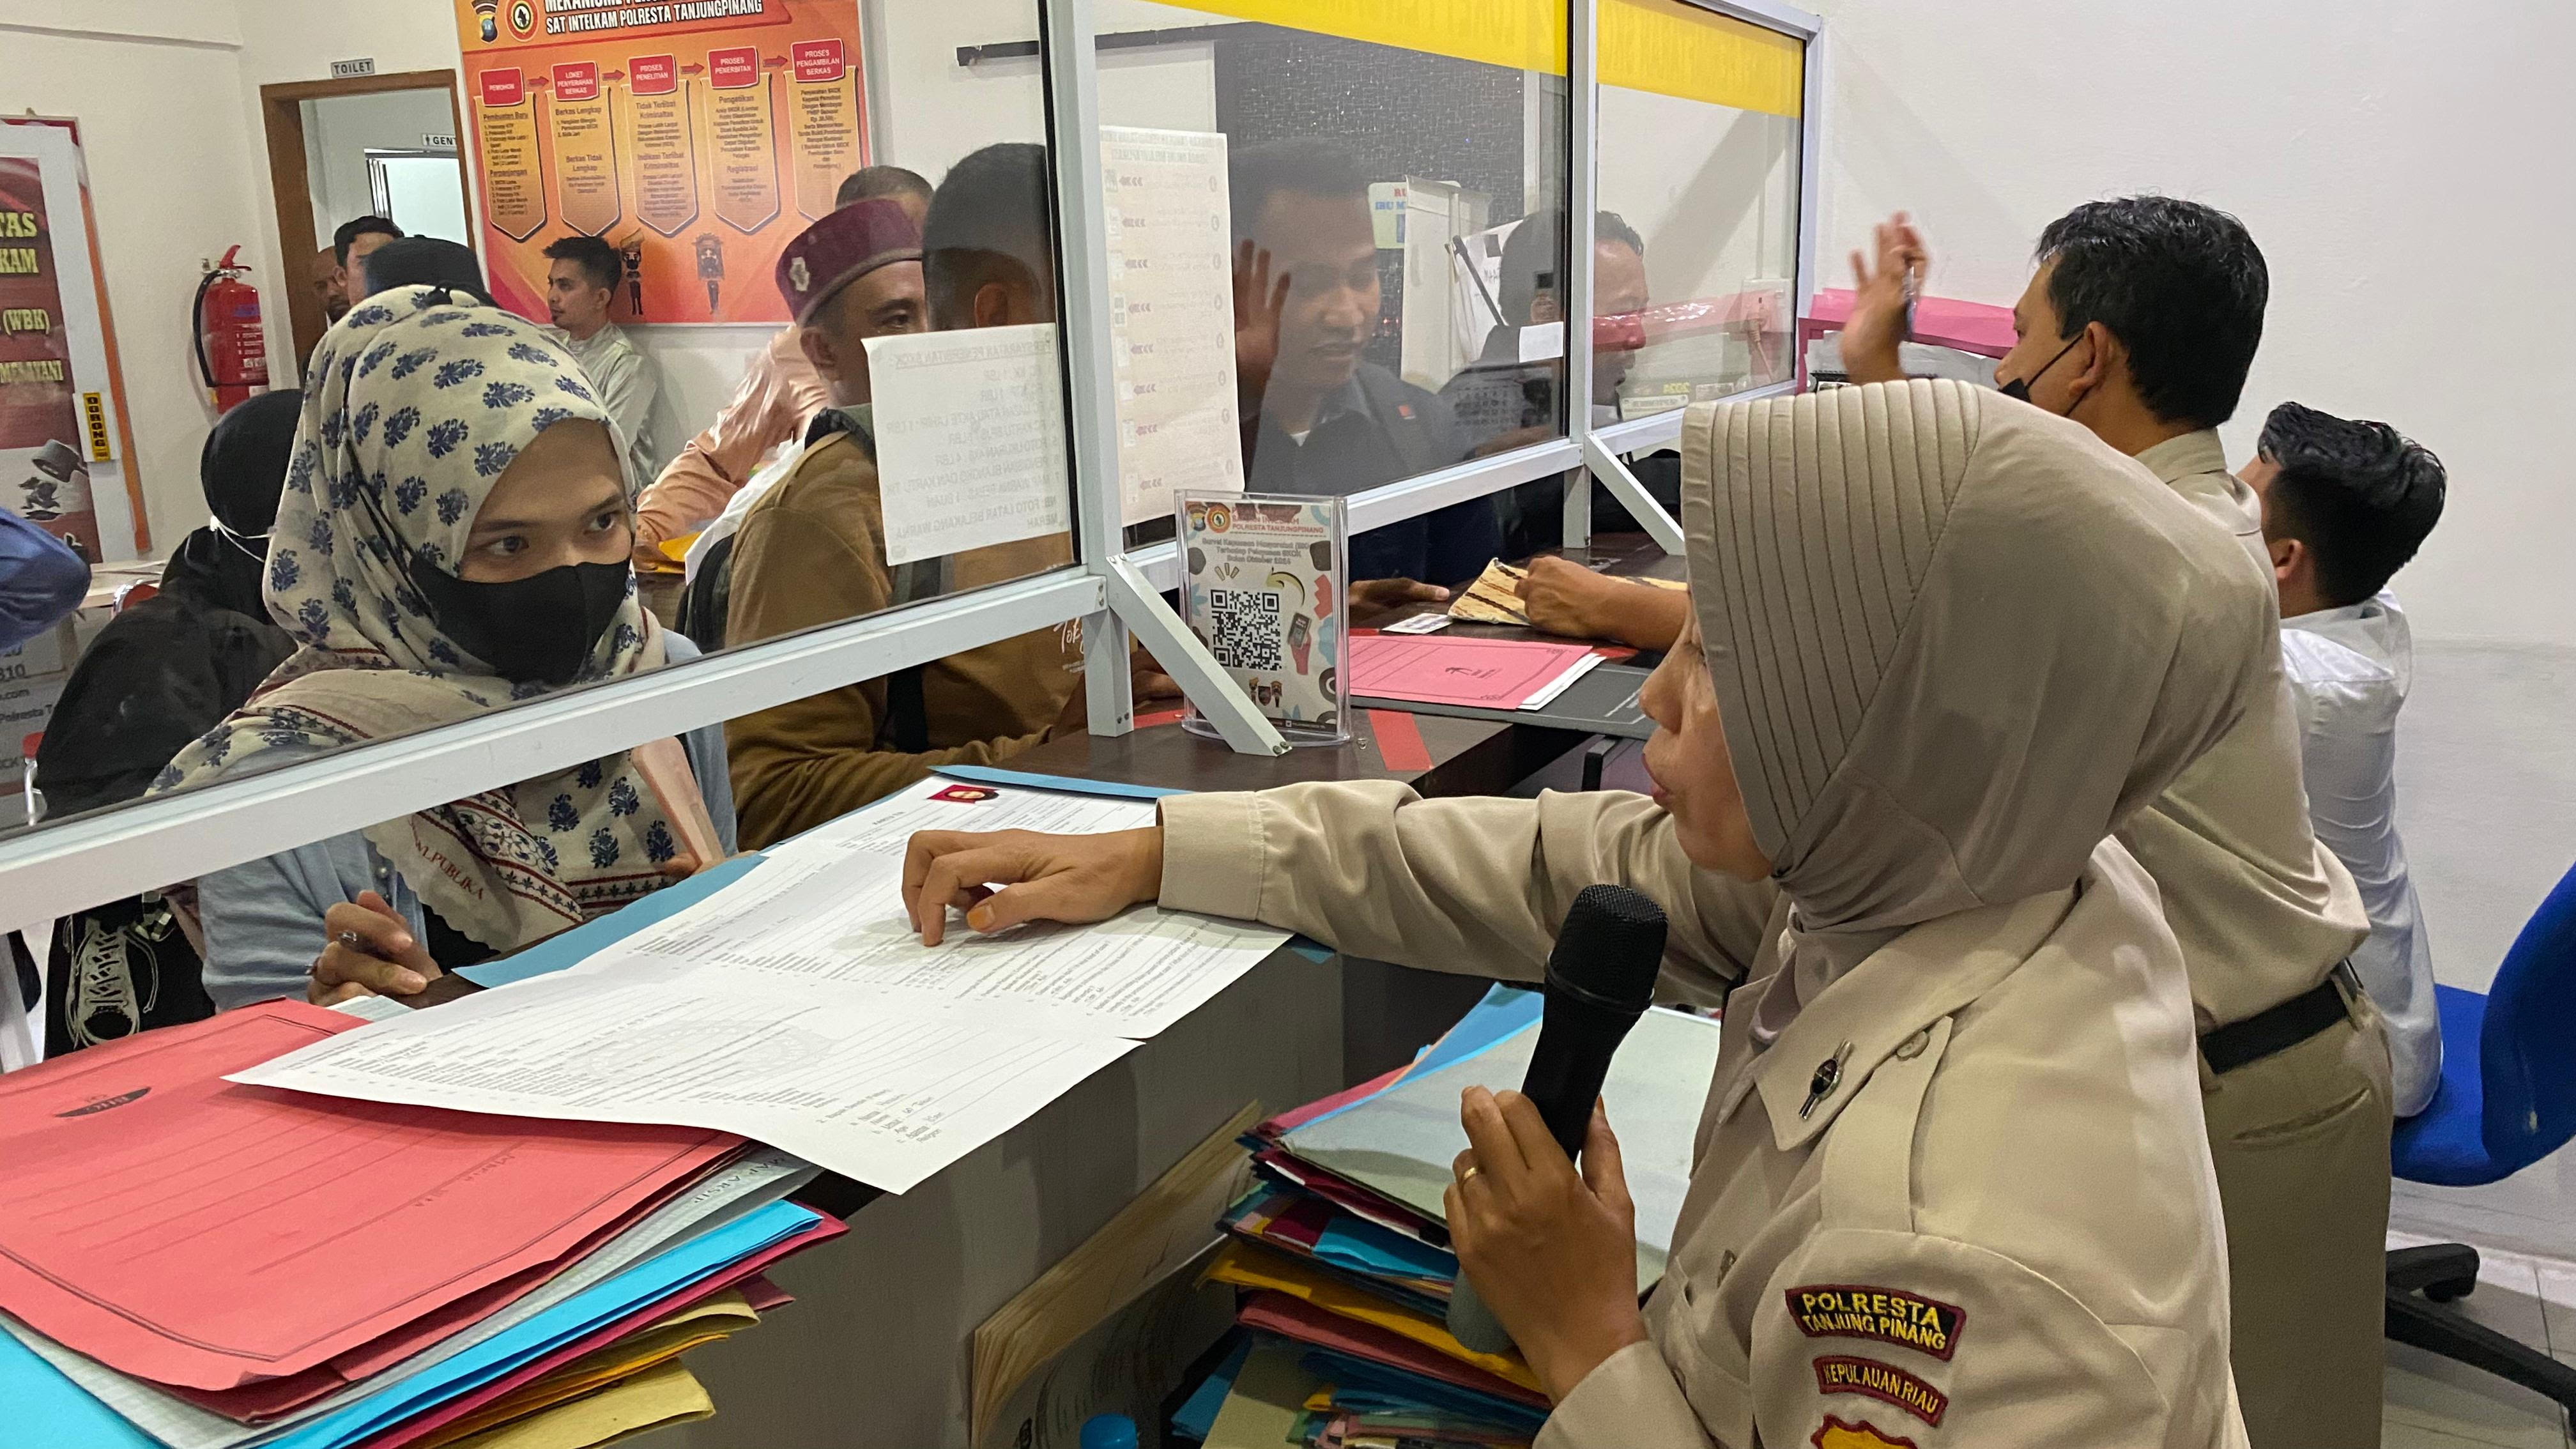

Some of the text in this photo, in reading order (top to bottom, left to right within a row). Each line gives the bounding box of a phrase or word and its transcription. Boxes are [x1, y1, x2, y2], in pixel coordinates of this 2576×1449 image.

[546, 17, 565, 34] SAT
[569, 11, 618, 31] INTELKAM
[619, 5, 671, 27] POLRESTA
[673, 0, 762, 20] TANJUNGPINANG
[796, 57, 839, 67] PENGAMBILAN
[805, 49, 830, 57] PROSES
[334, 61, 371, 75] TOILET
[640, 64, 663, 72] PROSES
[715, 65, 751, 74] PENERBITAN
[806, 67, 831, 76] BERKAS
[3, 309, 50, 336] (WBK)
[86, 396, 106, 447] DORONG
[1267, 525, 1324, 533] TANJUNGPINANG
[694, 1176, 741, 1203] ARSIP
[1802, 1292, 1940, 1331] POLRESTA
[1802, 1313, 1946, 1350] TANJUNG PINANG
[1823, 1363, 1939, 1414] KEPULAUAN RIAU
